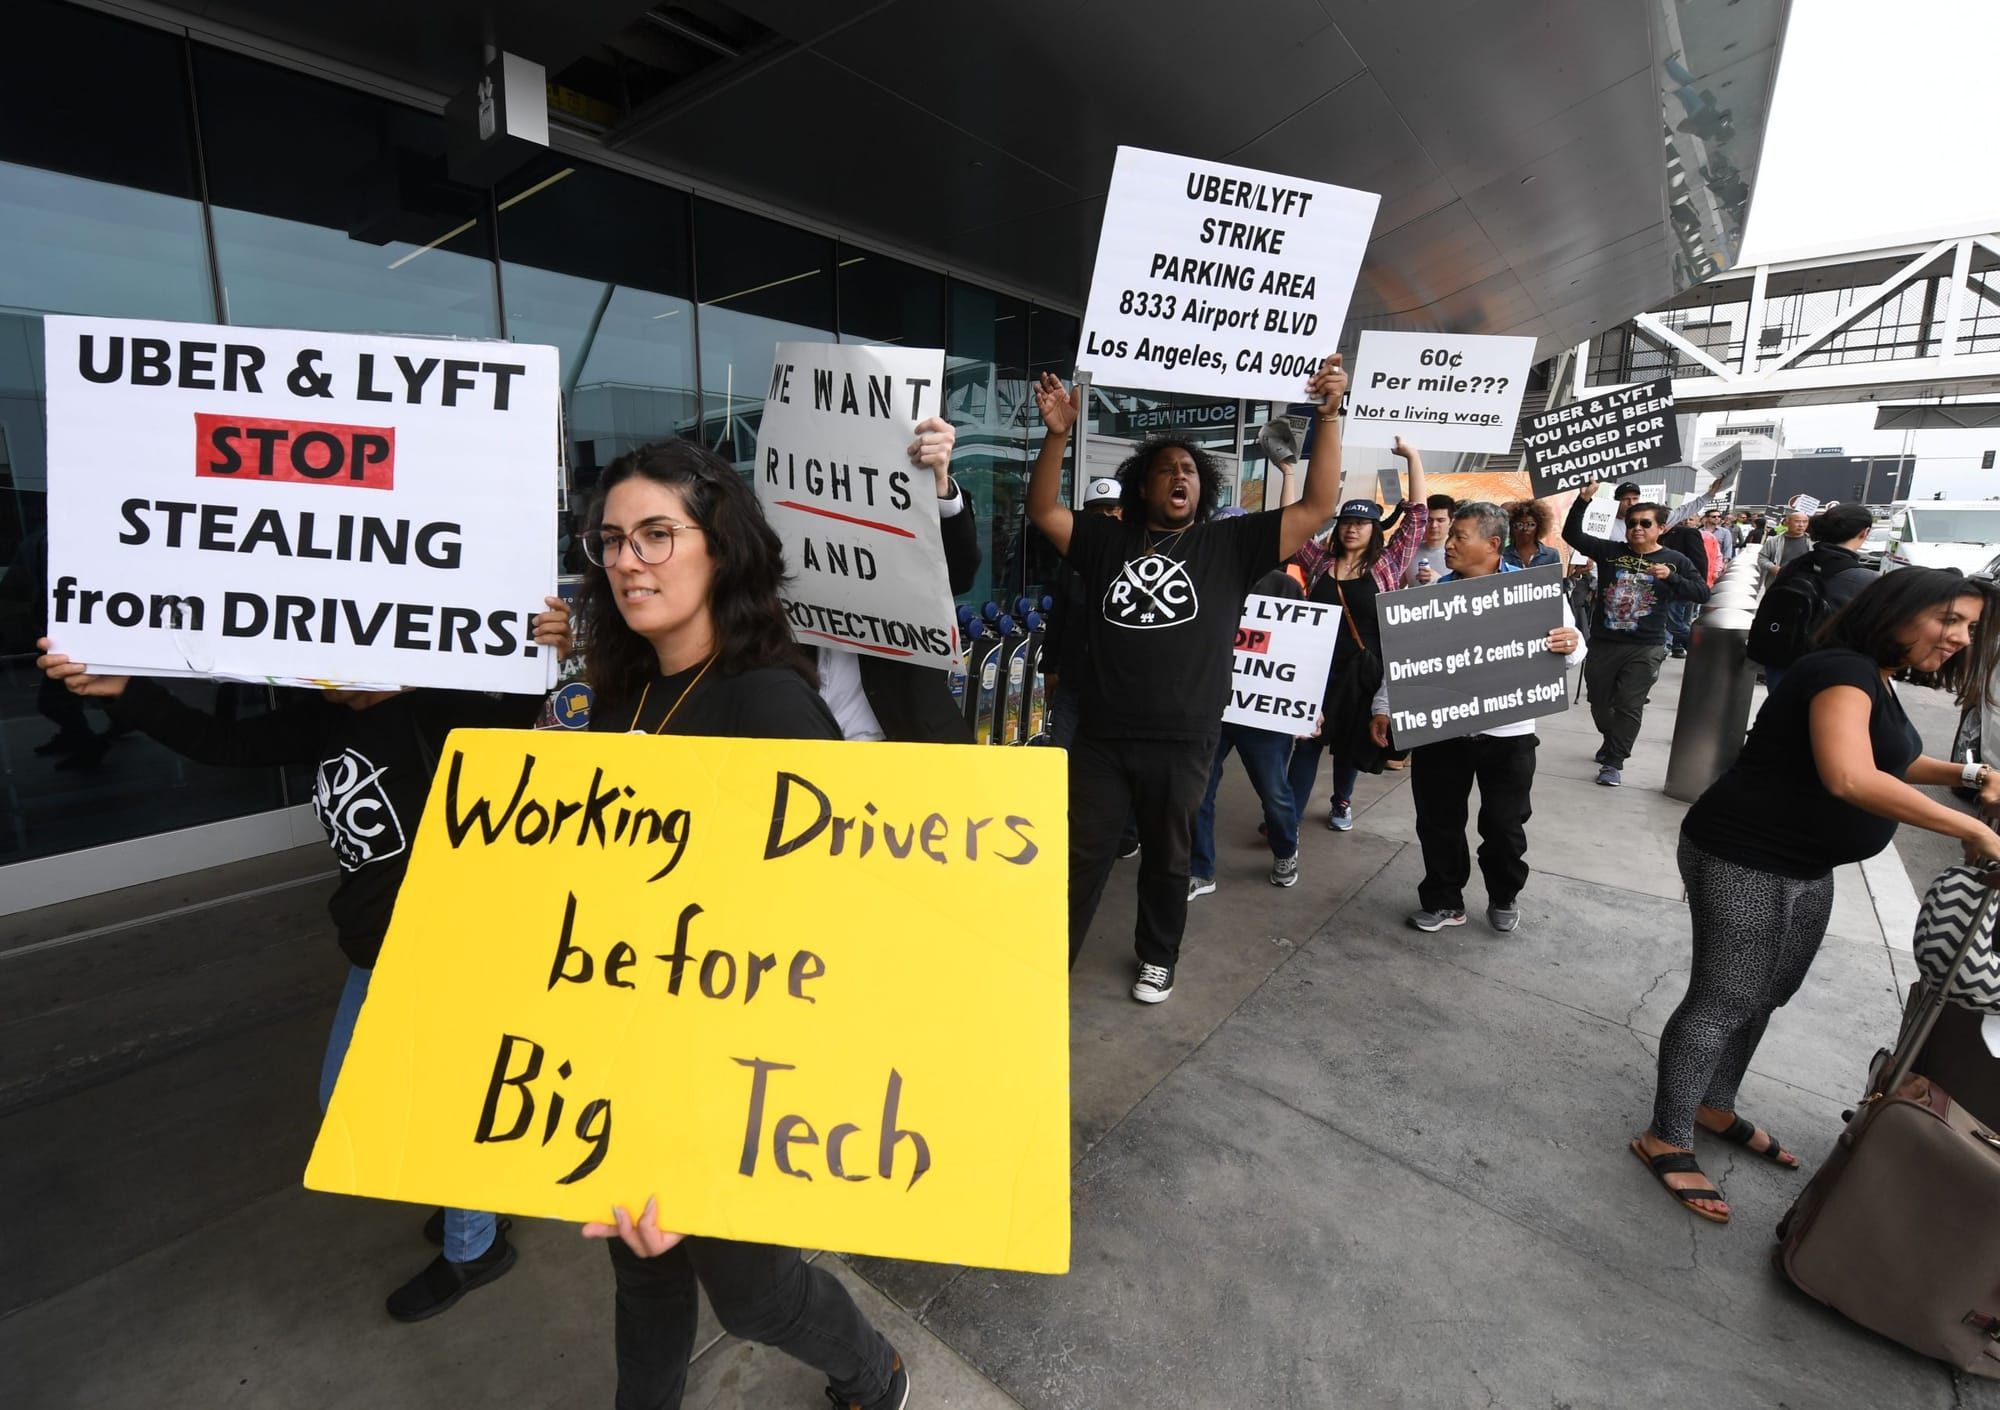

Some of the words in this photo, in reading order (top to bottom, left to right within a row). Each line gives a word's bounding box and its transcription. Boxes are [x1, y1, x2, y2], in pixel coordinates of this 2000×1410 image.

[1186, 172, 1313, 218] UBER/LYFT
[1200, 217, 1285, 255] STRIKE
[1149, 253, 1255, 291] PARKING
[1259, 270, 1316, 300] AREA
[1119, 290, 1176, 320] 8333
[1182, 299, 1259, 331] Airport
[1264, 309, 1318, 336] BLVD
[78, 334, 266, 394] UBER
[286, 348, 334, 399] &
[355, 353, 527, 411] LYFT
[1086, 331, 1128, 358] Los
[1134, 337, 1228, 374] Angeles,
[1235, 350, 1263, 374] CA
[1420, 349, 1463, 370] 60¢
[769, 363, 795, 404] WE
[814, 368, 931, 420] WANT
[1371, 372, 1411, 390] Per
[1417, 376, 1509, 394] mile???
[1355, 404, 1385, 418] Not
[1389, 409, 1400, 419] a
[1404, 405, 1449, 424] living
[1455, 412, 1503, 427] wage.
[1523, 428, 1562, 448] YOU
[1566, 412, 1617, 436] HAVE
[1622, 395, 1674, 420] BEEN
[1533, 406, 1584, 429] UBER
[1589, 400, 1603, 413] &
[1609, 384, 1655, 408] LYFT
[209, 426, 391, 480] STOP
[1535, 429, 1620, 463] FLAGGED
[1625, 417, 1664, 437] FOR
[1540, 435, 1664, 478] FRAUDULENT
[766, 447, 912, 510] RIGHTS
[1556, 456, 1648, 490] ACTIVITY!
[119, 498, 463, 569] STEALING
[804, 537, 877, 581] AND
[52, 576, 205, 631] from
[221, 591, 540, 659] DRIVERS!
[1256, 600, 1328, 626] LYFT
[1385, 599, 1468, 626] Uber/Lyft
[1471, 596, 1500, 618] get
[1503, 582, 1562, 606] billions
[779, 598, 959, 665] ROTECTIONS!
[1233, 628, 1265, 649] OP
[1232, 655, 1297, 682] LING
[1389, 656, 1443, 682] Drivers
[1446, 651, 1472, 674] get
[1473, 646, 1484, 665] 2
[1486, 639, 1525, 663] cents
[1228, 689, 1317, 722] IVERS!
[1392, 708, 1427, 732] The
[1431, 697, 1480, 729] greed
[1483, 687, 1523, 715] must
[1526, 677, 1566, 705] stop!
[444, 749, 691, 883] Working
[763, 770, 1040, 867] Drivers
[546, 890, 826, 1006] before
[474, 1033, 612, 1185] Big
[729, 1055, 931, 1193] Tech
